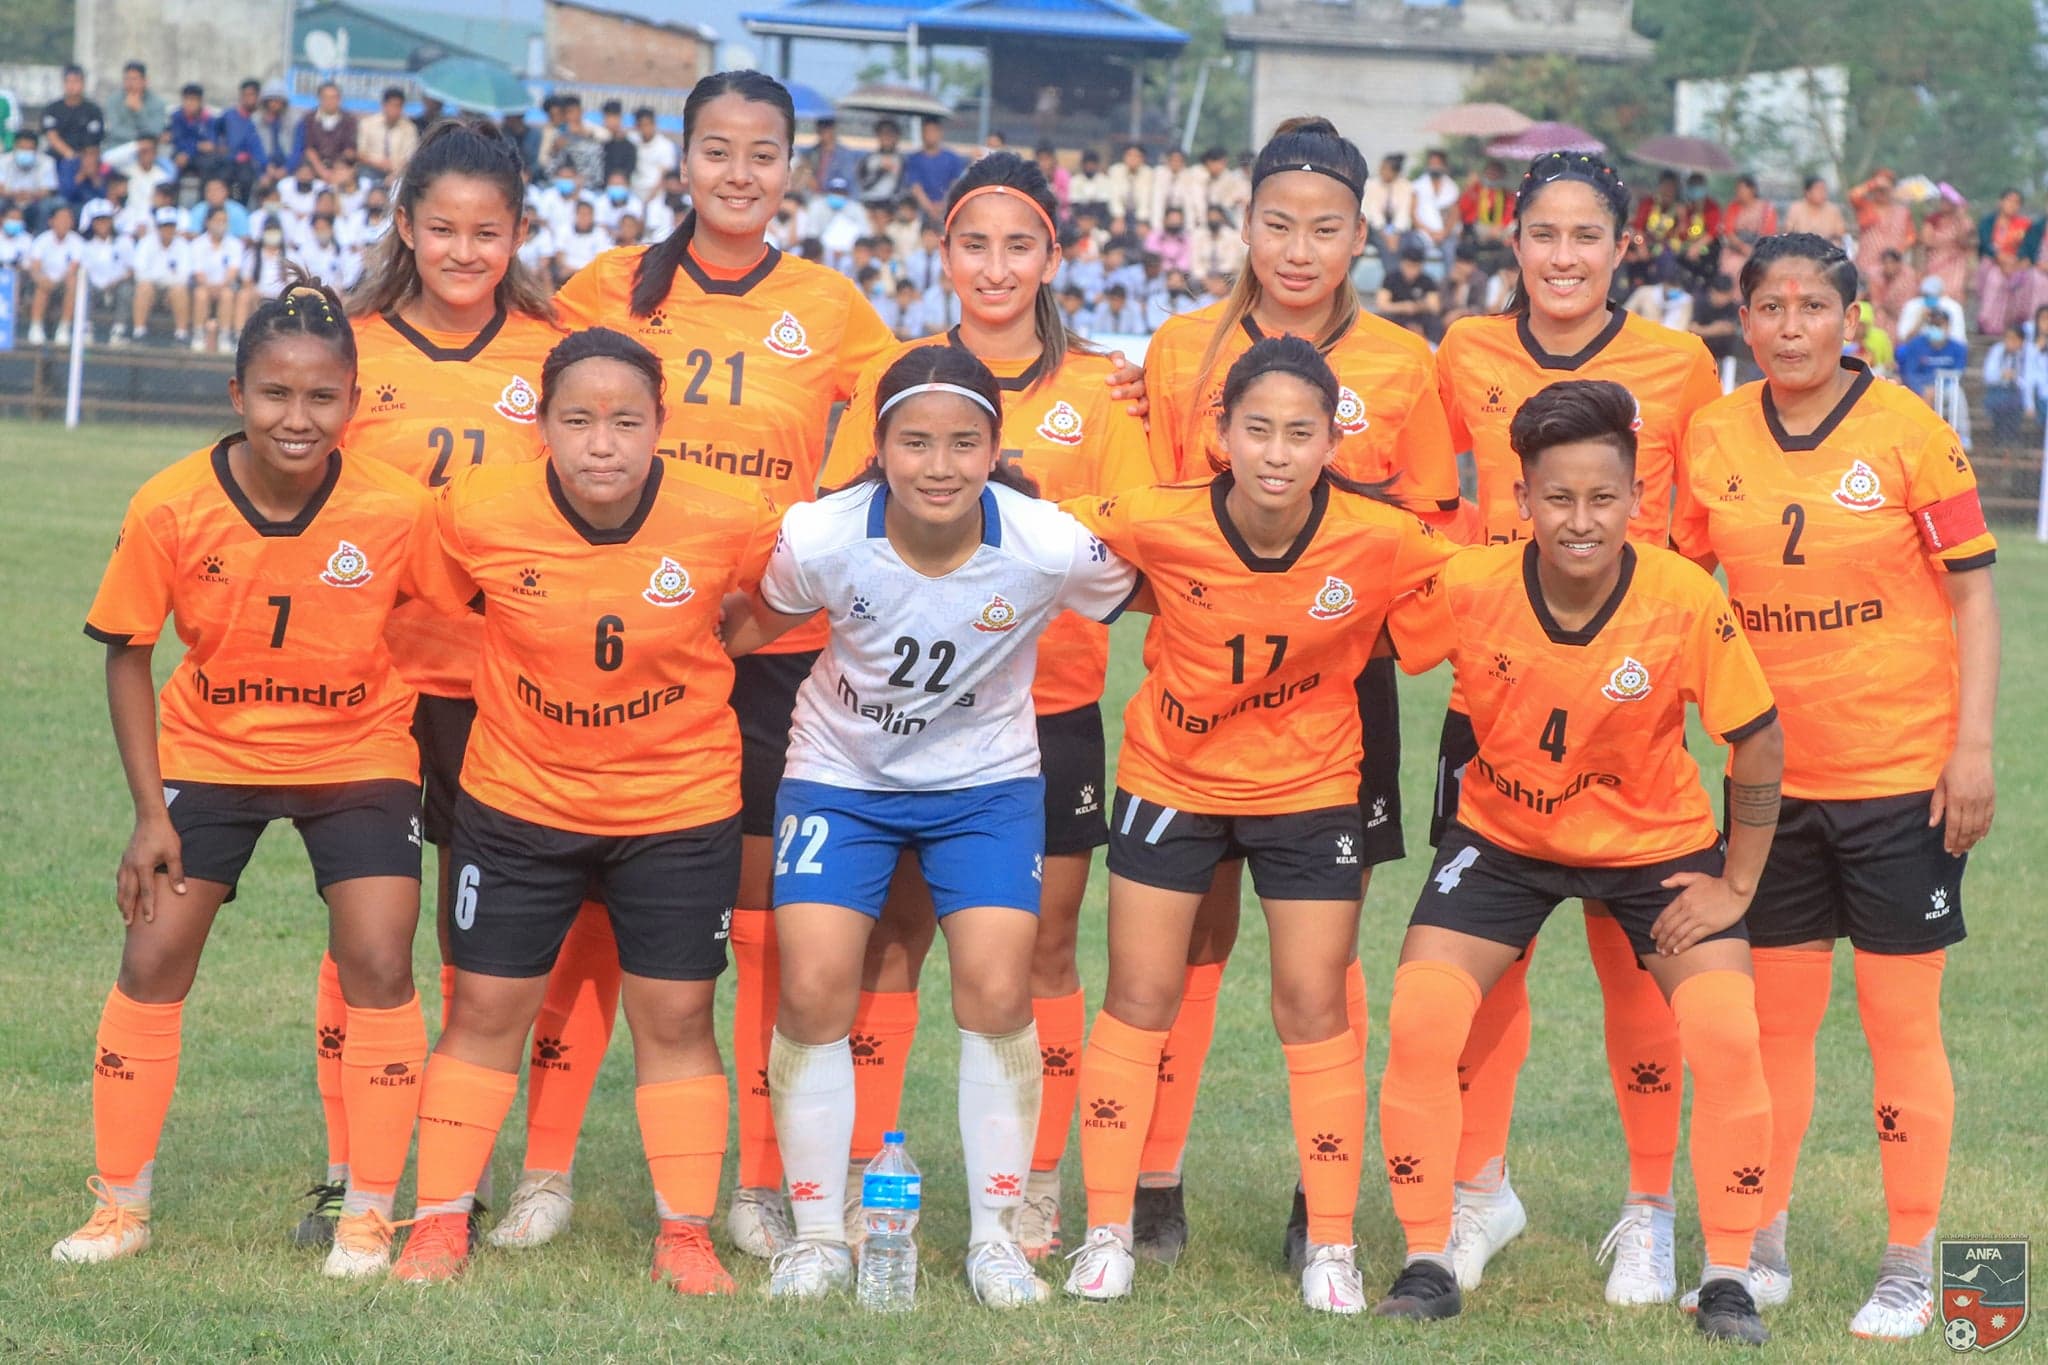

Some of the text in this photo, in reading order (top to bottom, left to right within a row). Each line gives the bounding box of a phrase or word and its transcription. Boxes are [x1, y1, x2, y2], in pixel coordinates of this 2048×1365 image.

[639, 328, 673, 336] KELME
[684, 349, 744, 406] 21
[371, 403, 407, 413] KELME
[1480, 406, 1506, 415] KELME
[428, 427, 485, 487] 27
[1781, 503, 1805, 566] 2
[198, 575, 231, 585] KELME
[512, 586, 549, 598] KELME
[1181, 592, 1213, 610] KELME
[268, 596, 291, 649] 7
[850, 611, 878, 622] ELME
[594, 614, 625, 672] 6
[888, 636, 957, 693] 22
[1225, 634, 1288, 685] 17
[193, 669, 366, 708] Mahindra
[518, 673, 687, 727] Mahindra
[1539, 708, 1569, 763] 4
[774, 815, 830, 876] 22
[1434, 845, 1481, 894] 4
[454, 864, 481, 931] 6
[95, 1064, 135, 1081] KELME
[531, 1059, 571, 1072] KELME
[1043, 1068, 1075, 1077] ELME
[370, 1075, 417, 1087] KELME
[1627, 1082, 1672, 1094] KELME
[1085, 1118, 1128, 1130] KELME
[1878, 1131, 1908, 1143] KELME
[1310, 1152, 1350, 1162] KELME
[1389, 1175, 1425, 1185] KELME
[985, 1187, 1022, 1197] KELME
